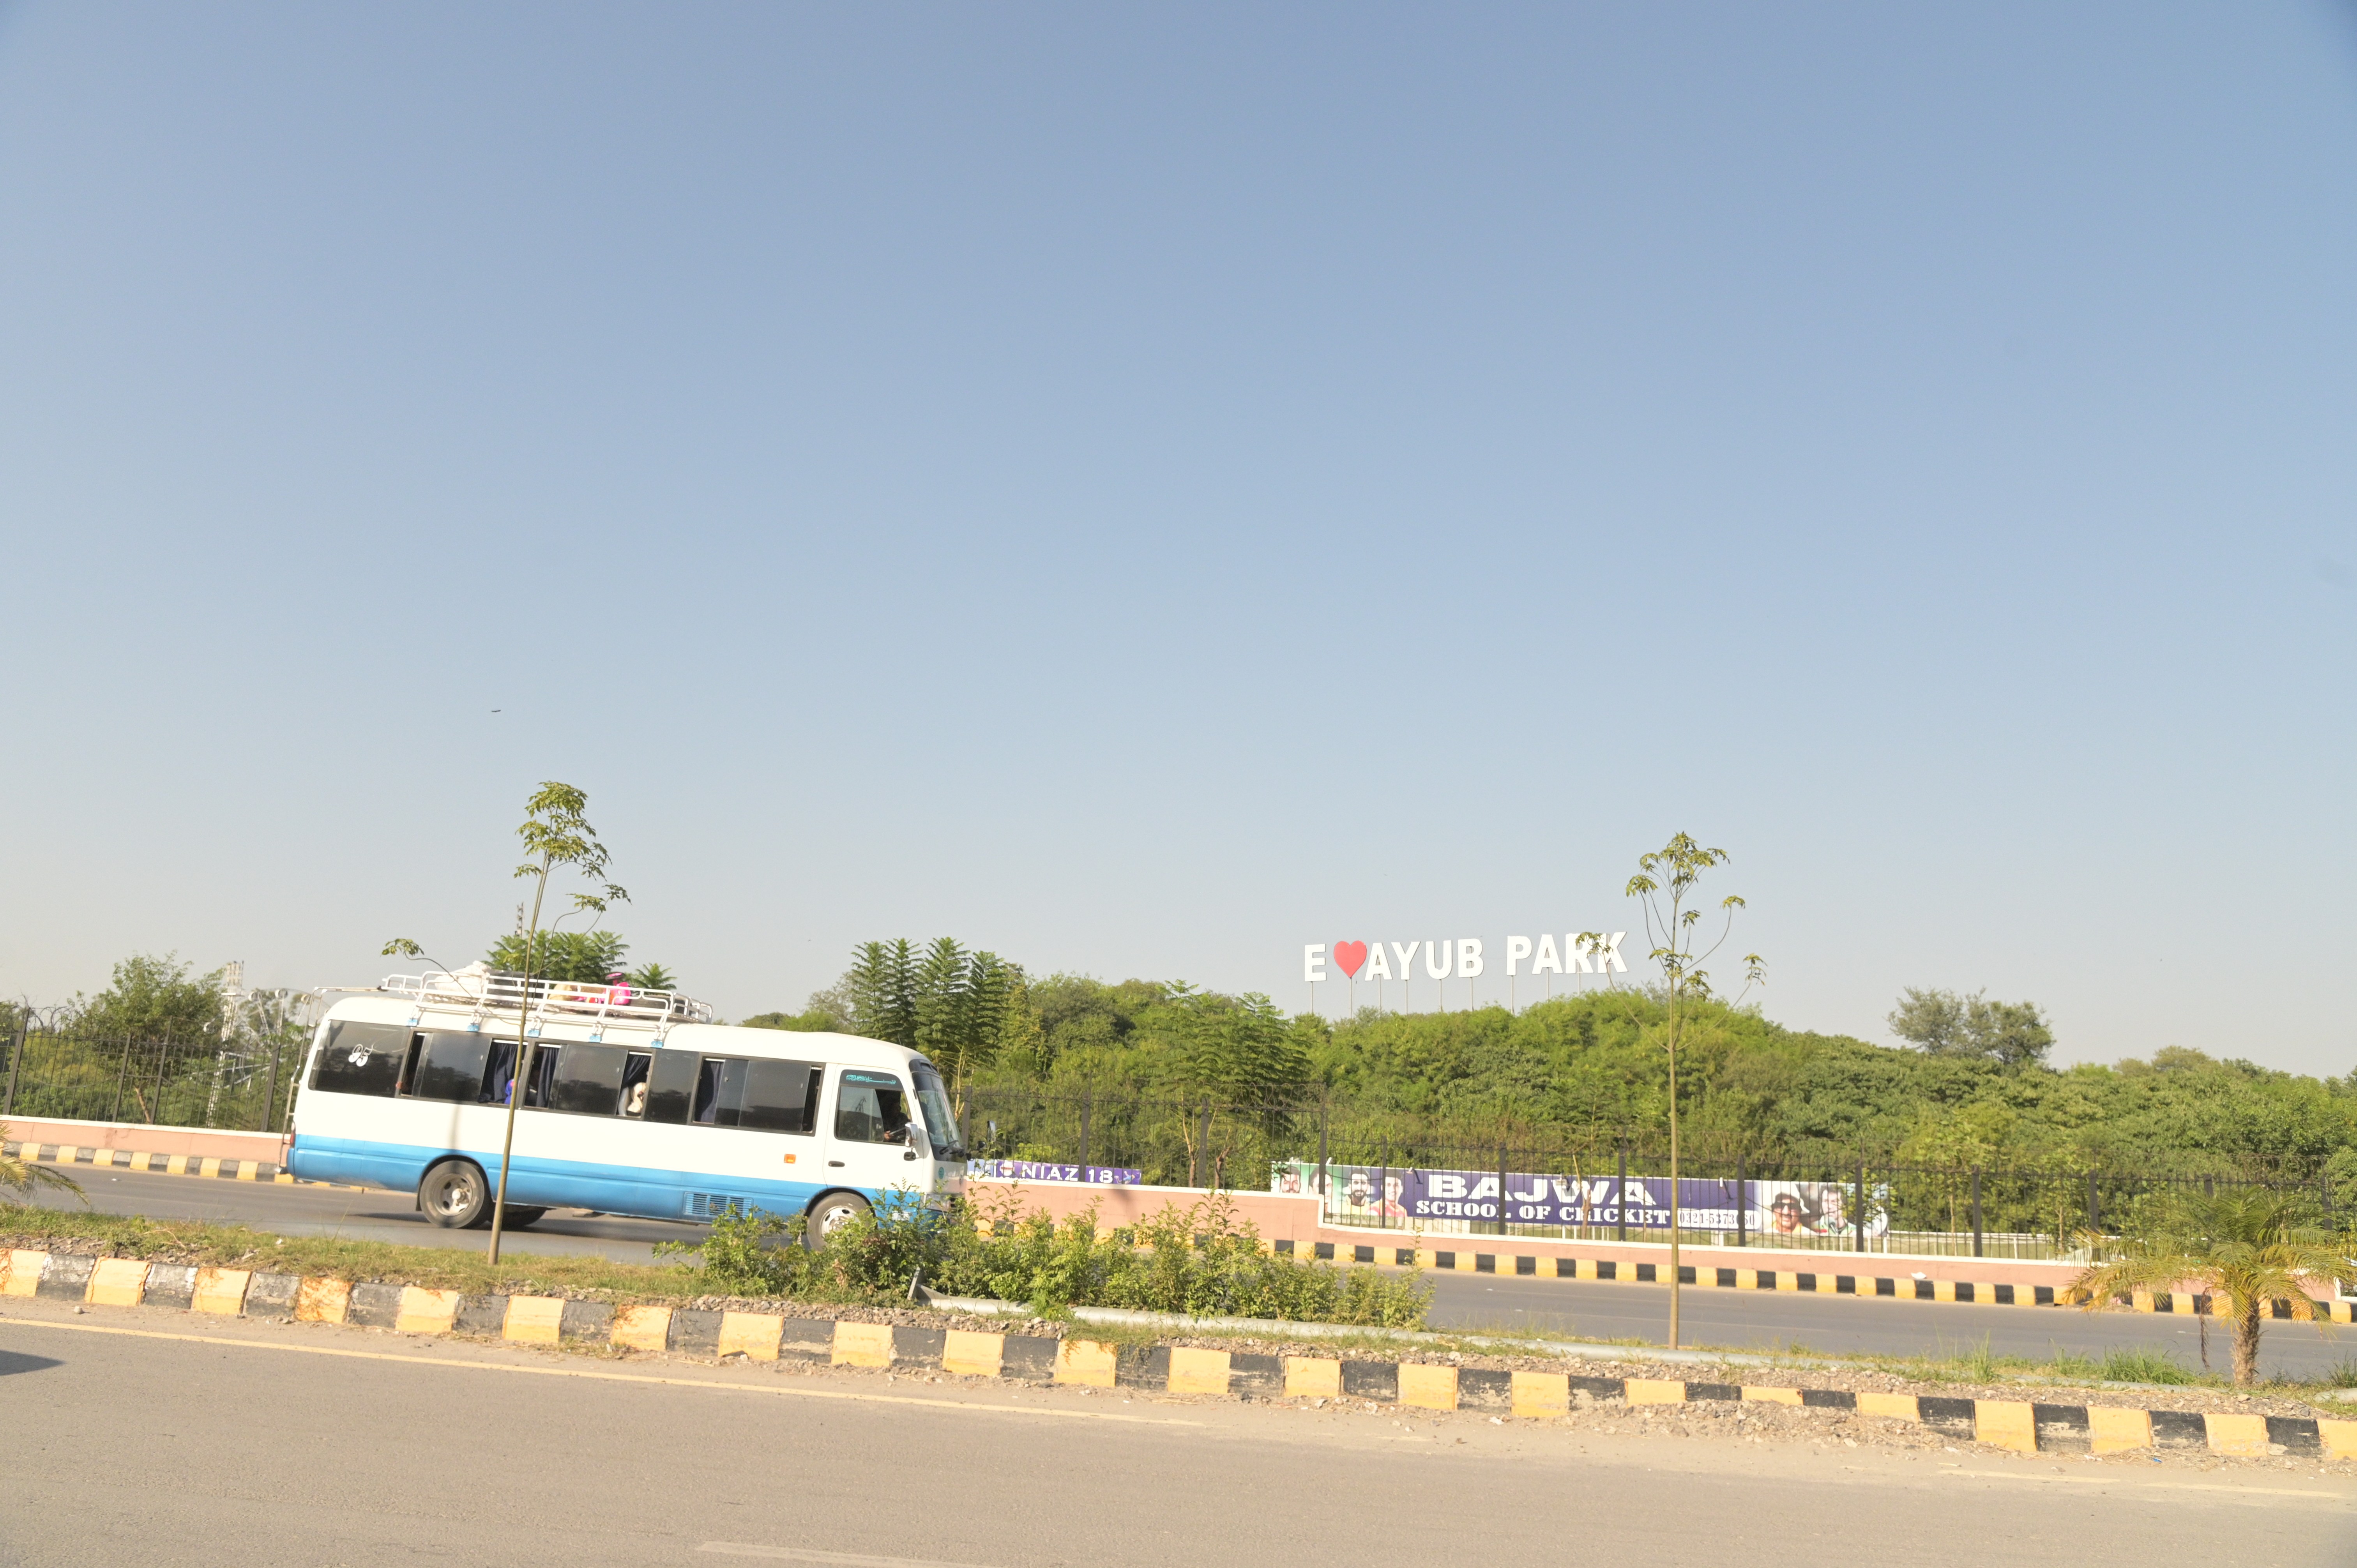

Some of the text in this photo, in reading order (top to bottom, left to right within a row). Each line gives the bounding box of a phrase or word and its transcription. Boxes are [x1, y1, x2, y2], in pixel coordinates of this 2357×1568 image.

[1304, 931, 1629, 982] E AYUB PARK
[348, 1044, 373, 1067] 95
[1022, 1164, 1113, 1183] NIAZ 18
[1428, 1174, 1657, 1206] BAJWA
[1519, 1205, 1551, 1220] OF
[1559, 1206, 1670, 1224] CRICKET
